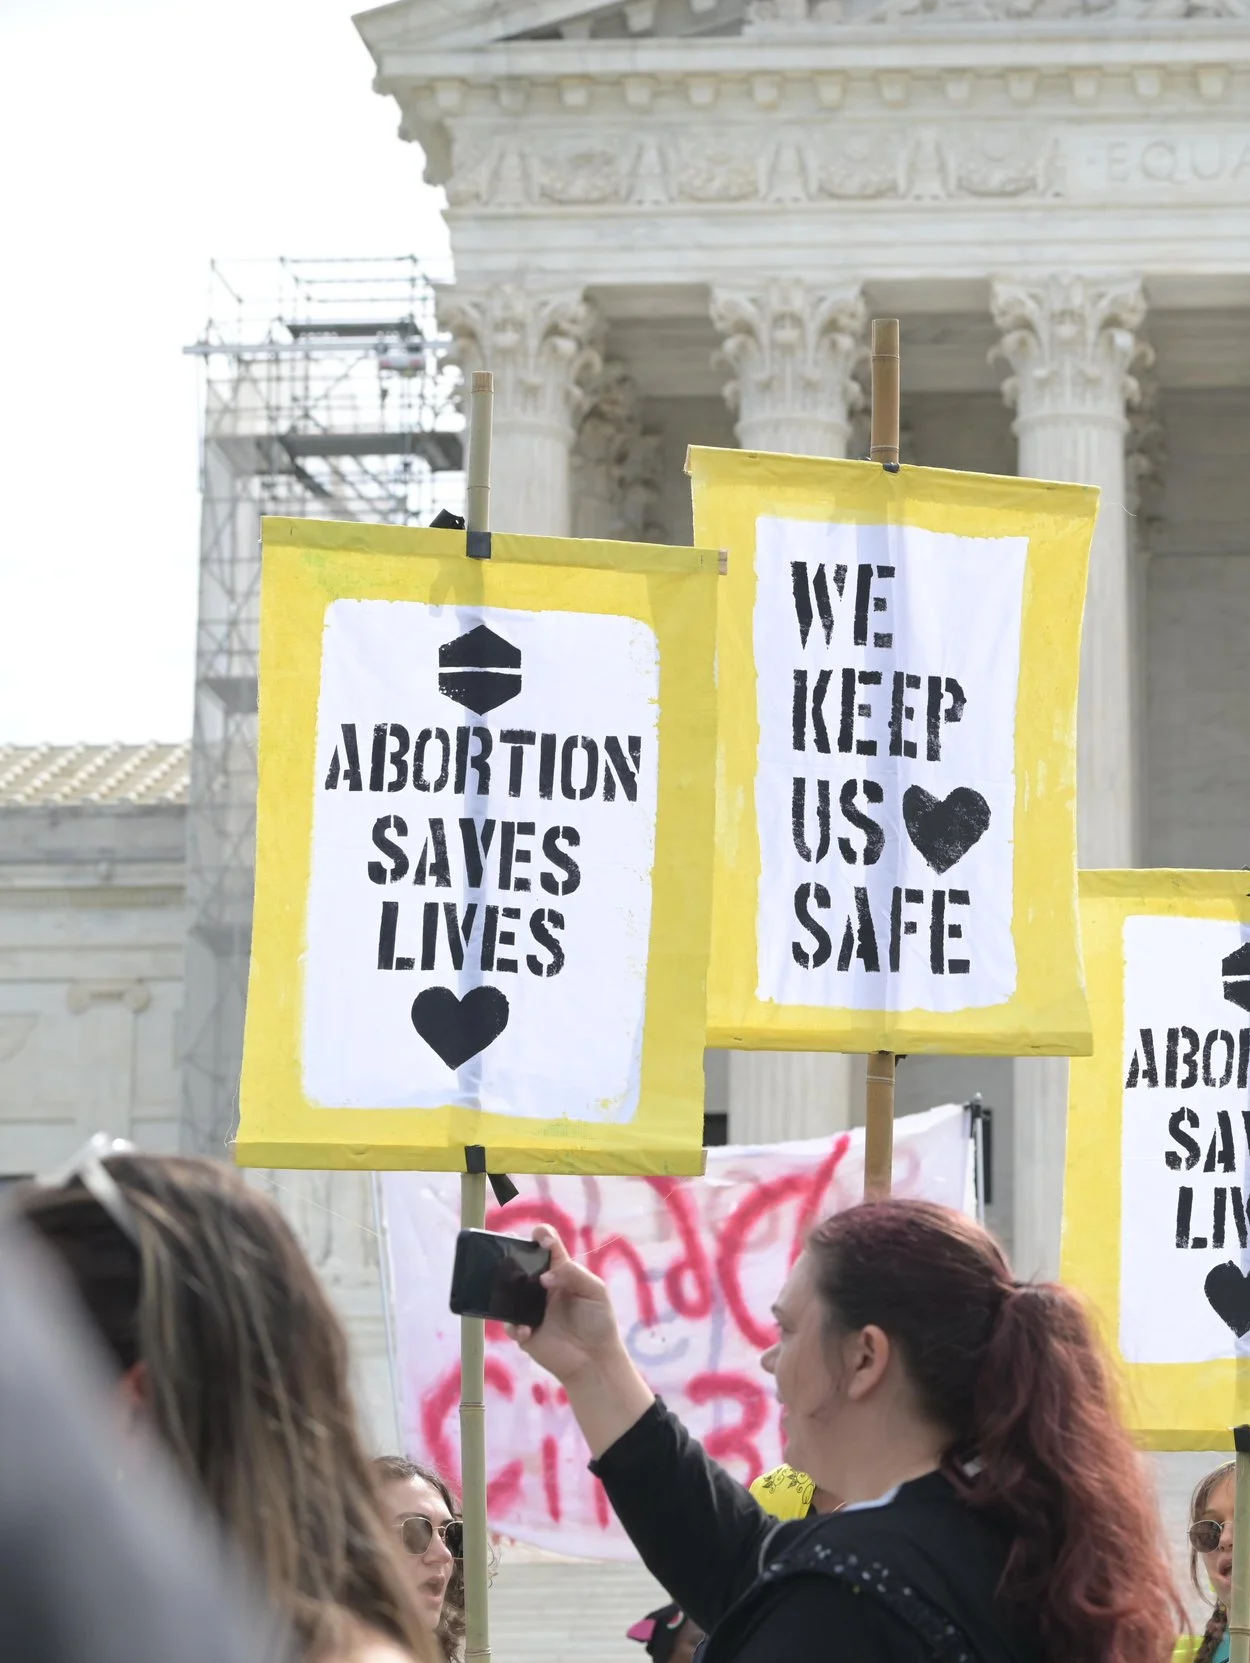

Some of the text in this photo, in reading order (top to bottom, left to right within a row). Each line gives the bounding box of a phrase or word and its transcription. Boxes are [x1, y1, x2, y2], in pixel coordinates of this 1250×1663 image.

[791, 561, 895, 649] WE
[793, 668, 966, 761] KEEP
[325, 724, 641, 802] ABORTION
[367, 814, 581, 896] SAVES
[792, 777, 885, 865] US
[378, 901, 566, 977] LIVES
[792, 882, 970, 974] SAFE
